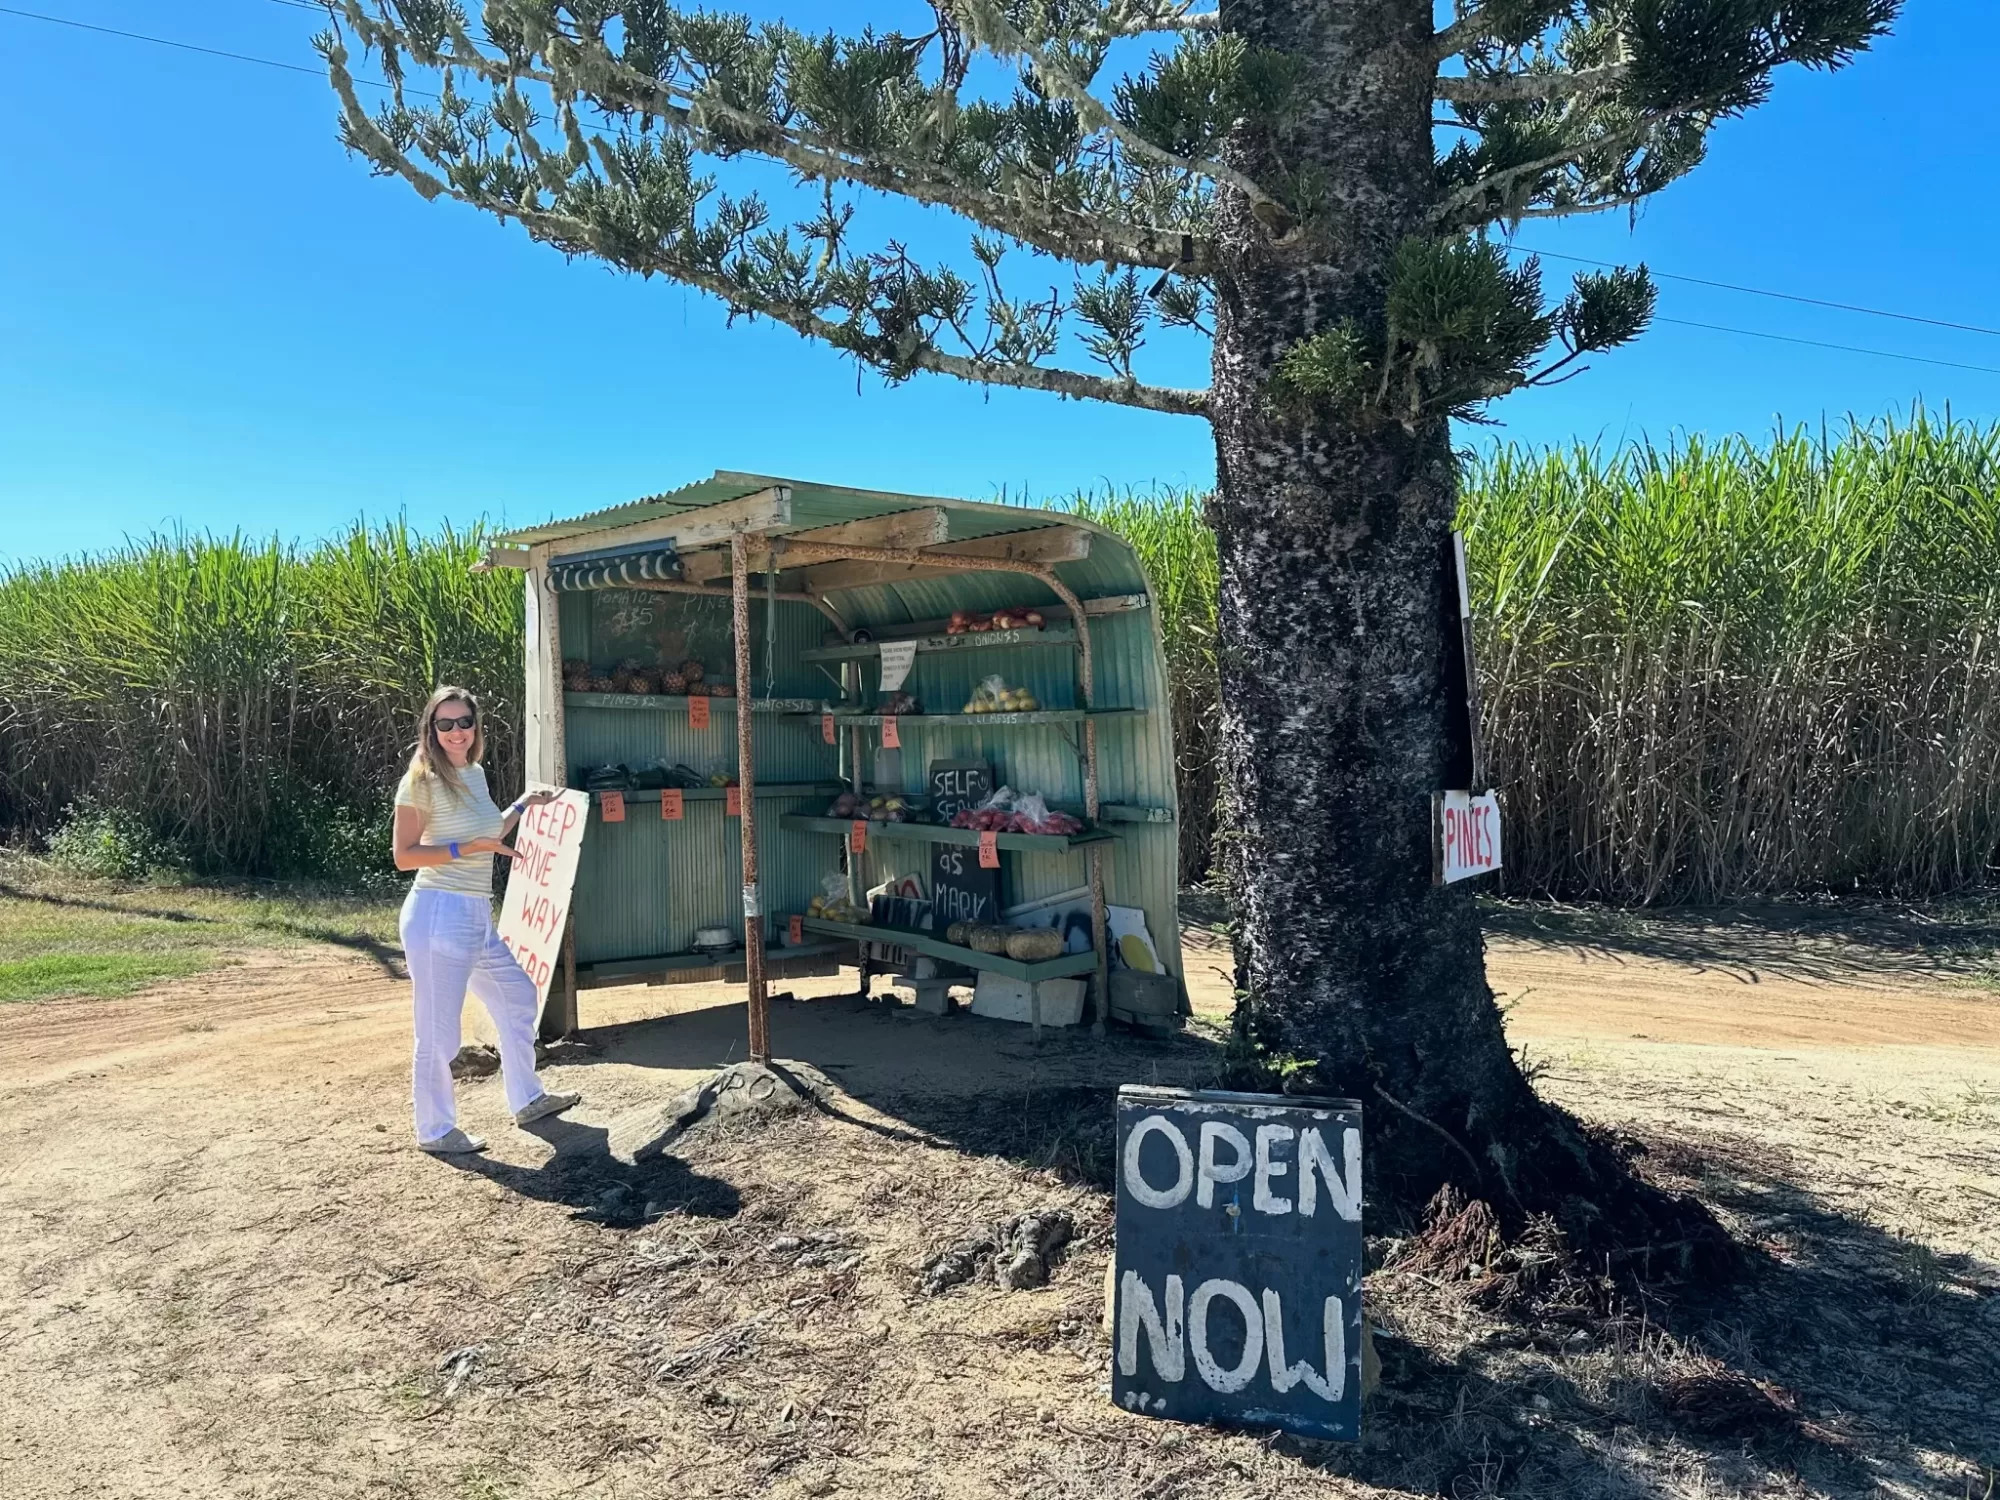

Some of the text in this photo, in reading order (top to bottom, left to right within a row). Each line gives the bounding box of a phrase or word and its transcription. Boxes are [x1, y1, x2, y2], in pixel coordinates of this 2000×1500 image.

[680, 592, 733, 615] PINE
[602, 694, 656, 707] PINES $2
[748, 699, 799, 712] OMATOES
[934, 770, 979, 798] SELF
[526, 801, 577, 846] KEEP
[1446, 805, 1492, 868] PINES
[512, 836, 557, 887] DRIVE
[522, 893, 563, 944] WAY
[501, 935, 550, 1003] EAR
[1123, 1115, 1362, 1222] OPEN
[1118, 1269, 1346, 1403] NOW
